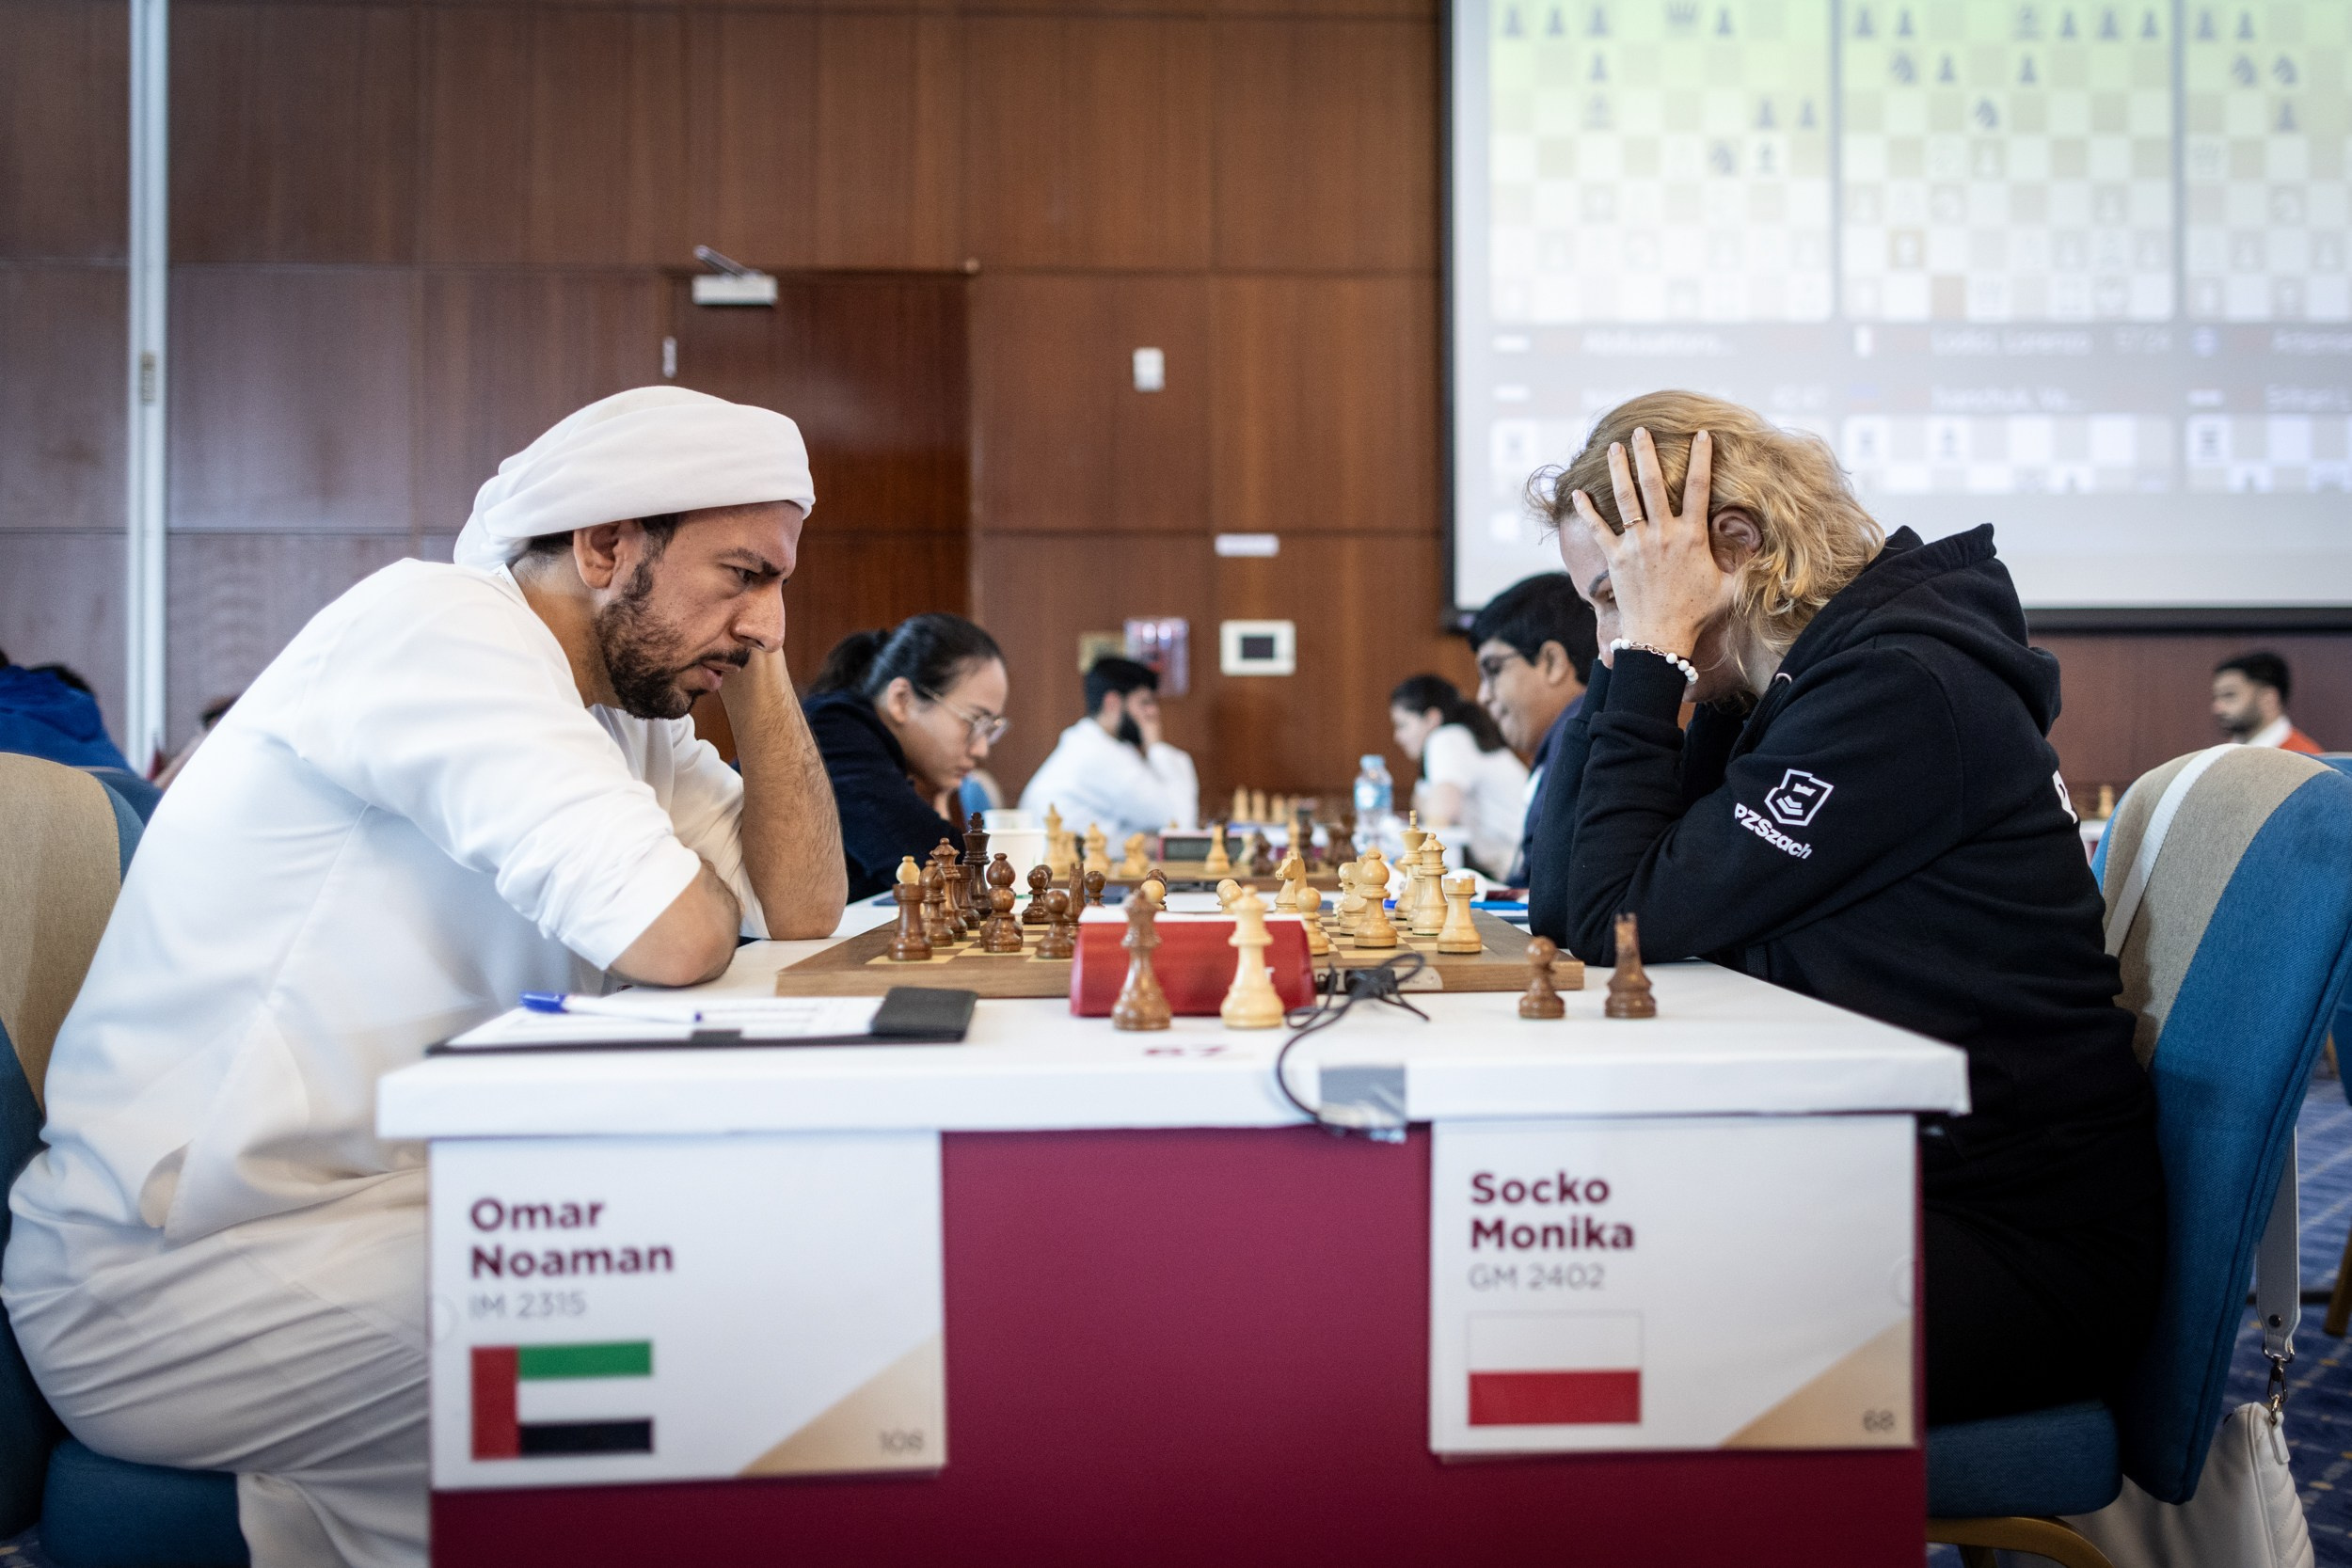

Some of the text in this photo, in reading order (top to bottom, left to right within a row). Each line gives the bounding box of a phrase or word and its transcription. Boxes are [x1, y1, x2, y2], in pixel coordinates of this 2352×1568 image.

[1735, 802, 1813, 860] PZSzach
[1470, 1171, 1611, 1206] Socko
[469, 1196, 605, 1232] Omar
[1470, 1216, 1636, 1251] Monika
[469, 1243, 675, 1279] Noaman
[1469, 1264, 1605, 1290] GM 2402
[469, 1291, 586, 1319] IM 2315
